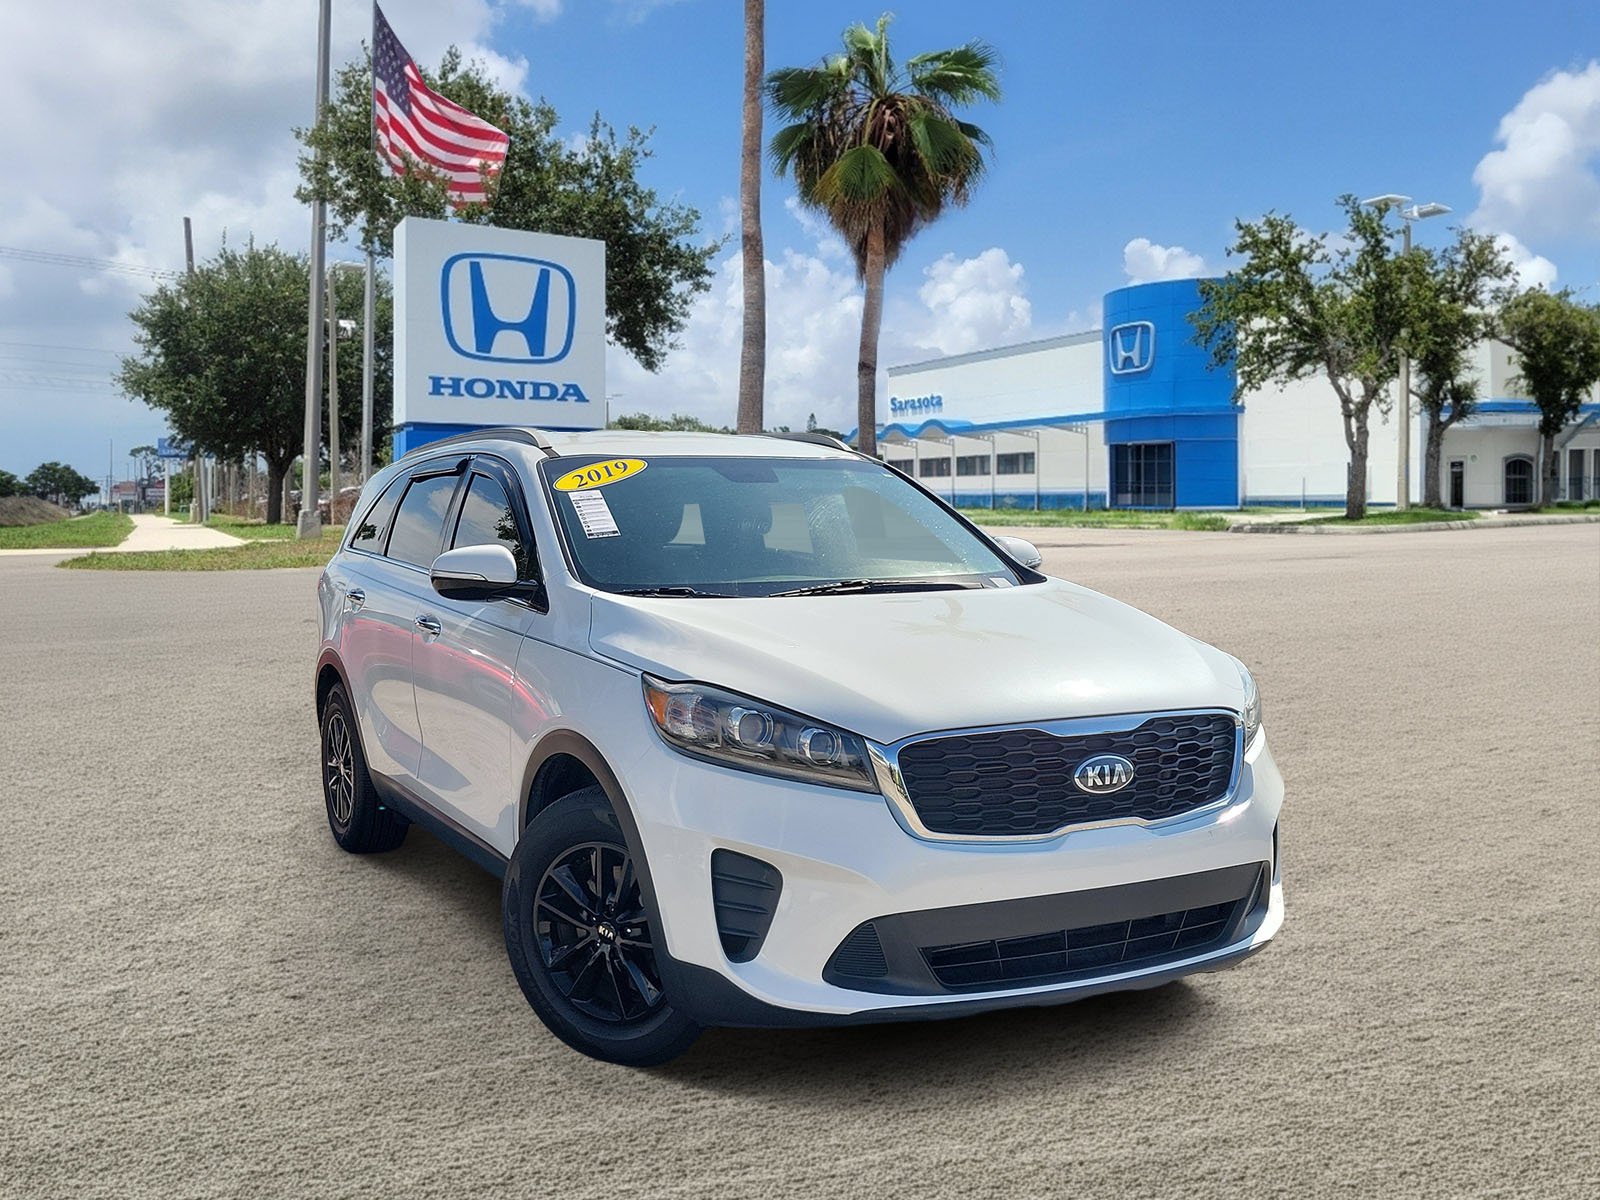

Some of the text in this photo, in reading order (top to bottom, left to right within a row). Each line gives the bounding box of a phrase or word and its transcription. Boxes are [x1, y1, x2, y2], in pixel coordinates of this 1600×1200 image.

[428, 376, 590, 403] HONDA
[890, 394, 943, 412] Sarasota
[571, 461, 628, 488] 2019
[1086, 763, 1127, 787] KIA
[598, 925, 614, 941] KIA
